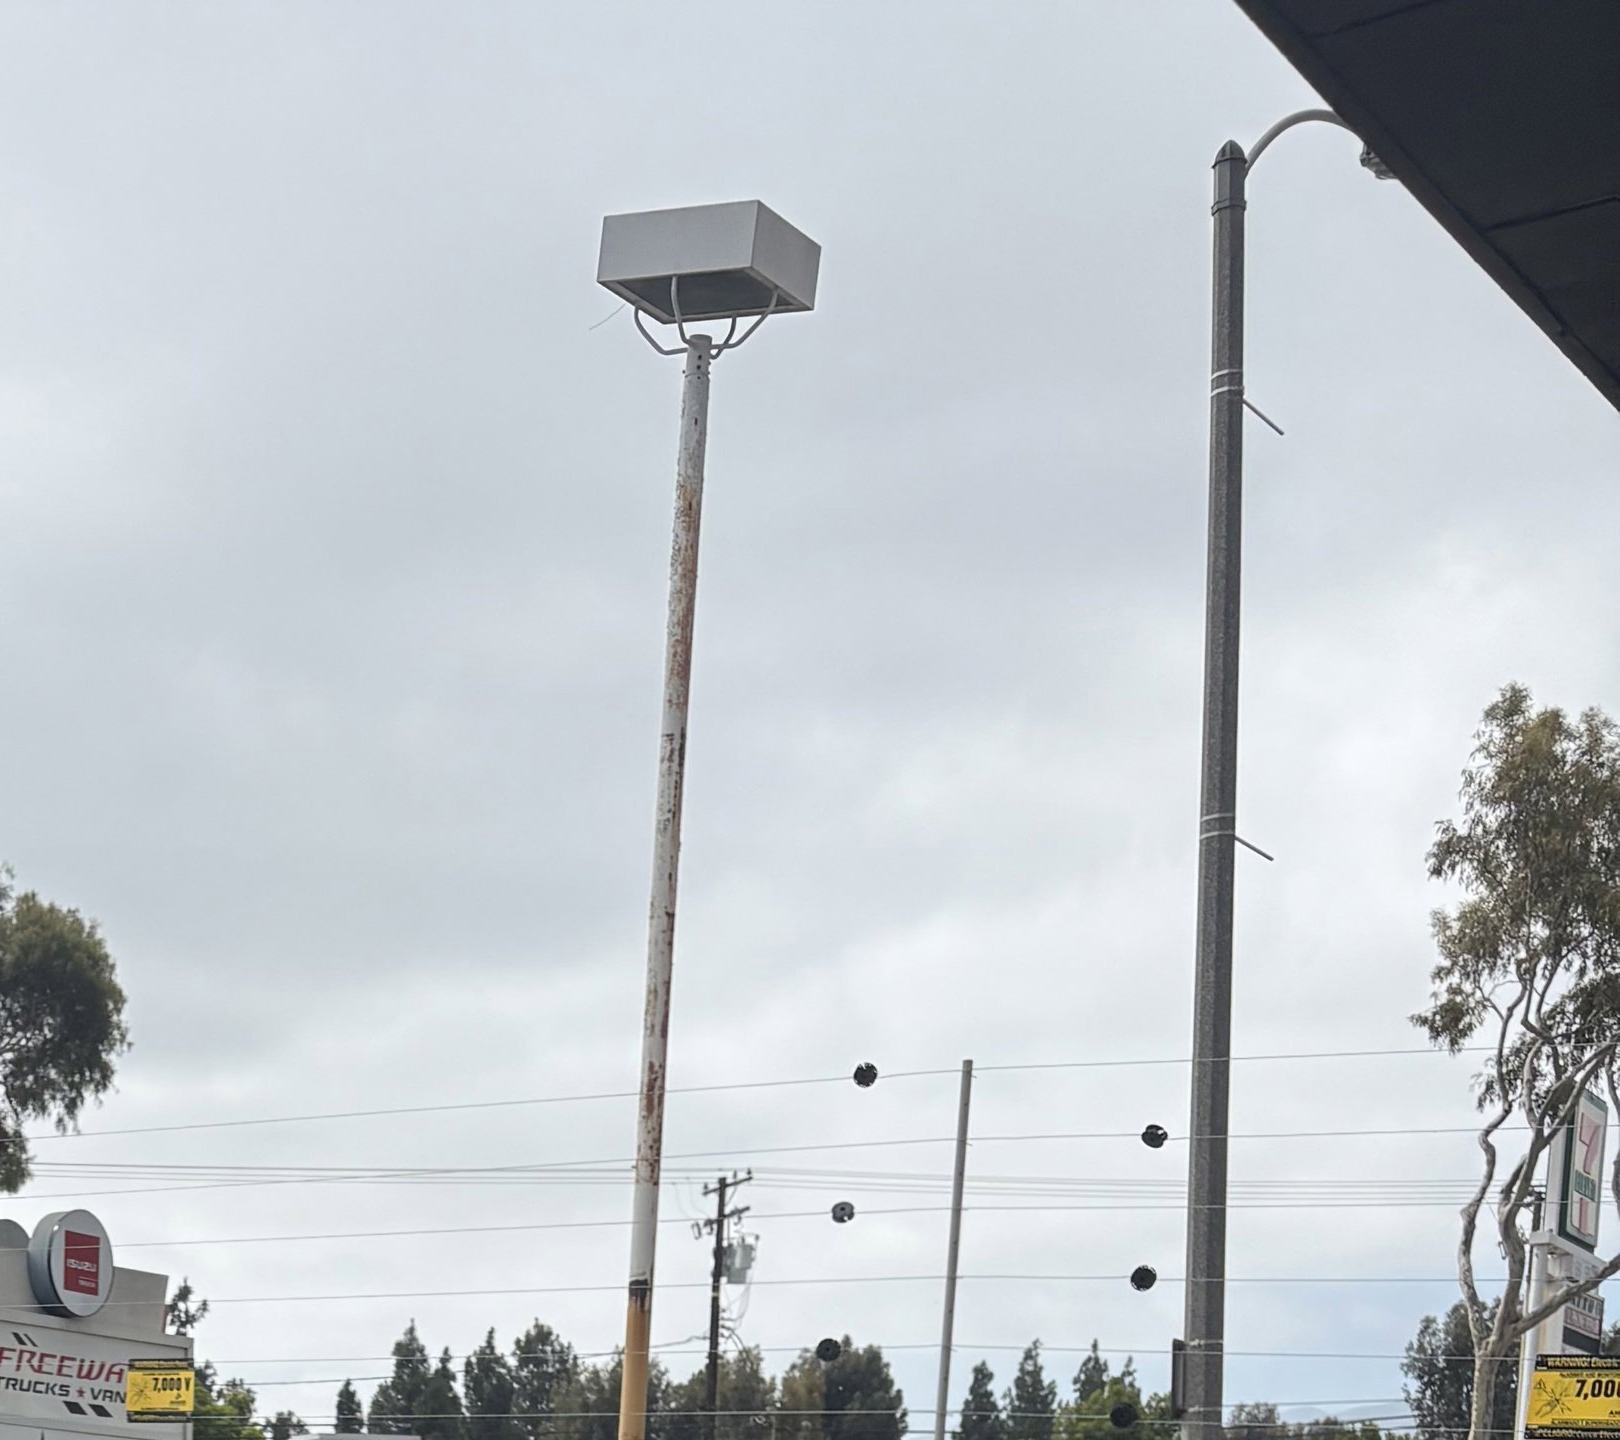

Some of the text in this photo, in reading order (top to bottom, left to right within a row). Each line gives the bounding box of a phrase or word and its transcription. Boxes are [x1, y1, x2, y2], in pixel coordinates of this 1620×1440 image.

[152, 1377, 182, 1393] 7,000
[1575, 1379, 1620, 1401] 7,00
[89, 1386, 129, 1404] VAN
